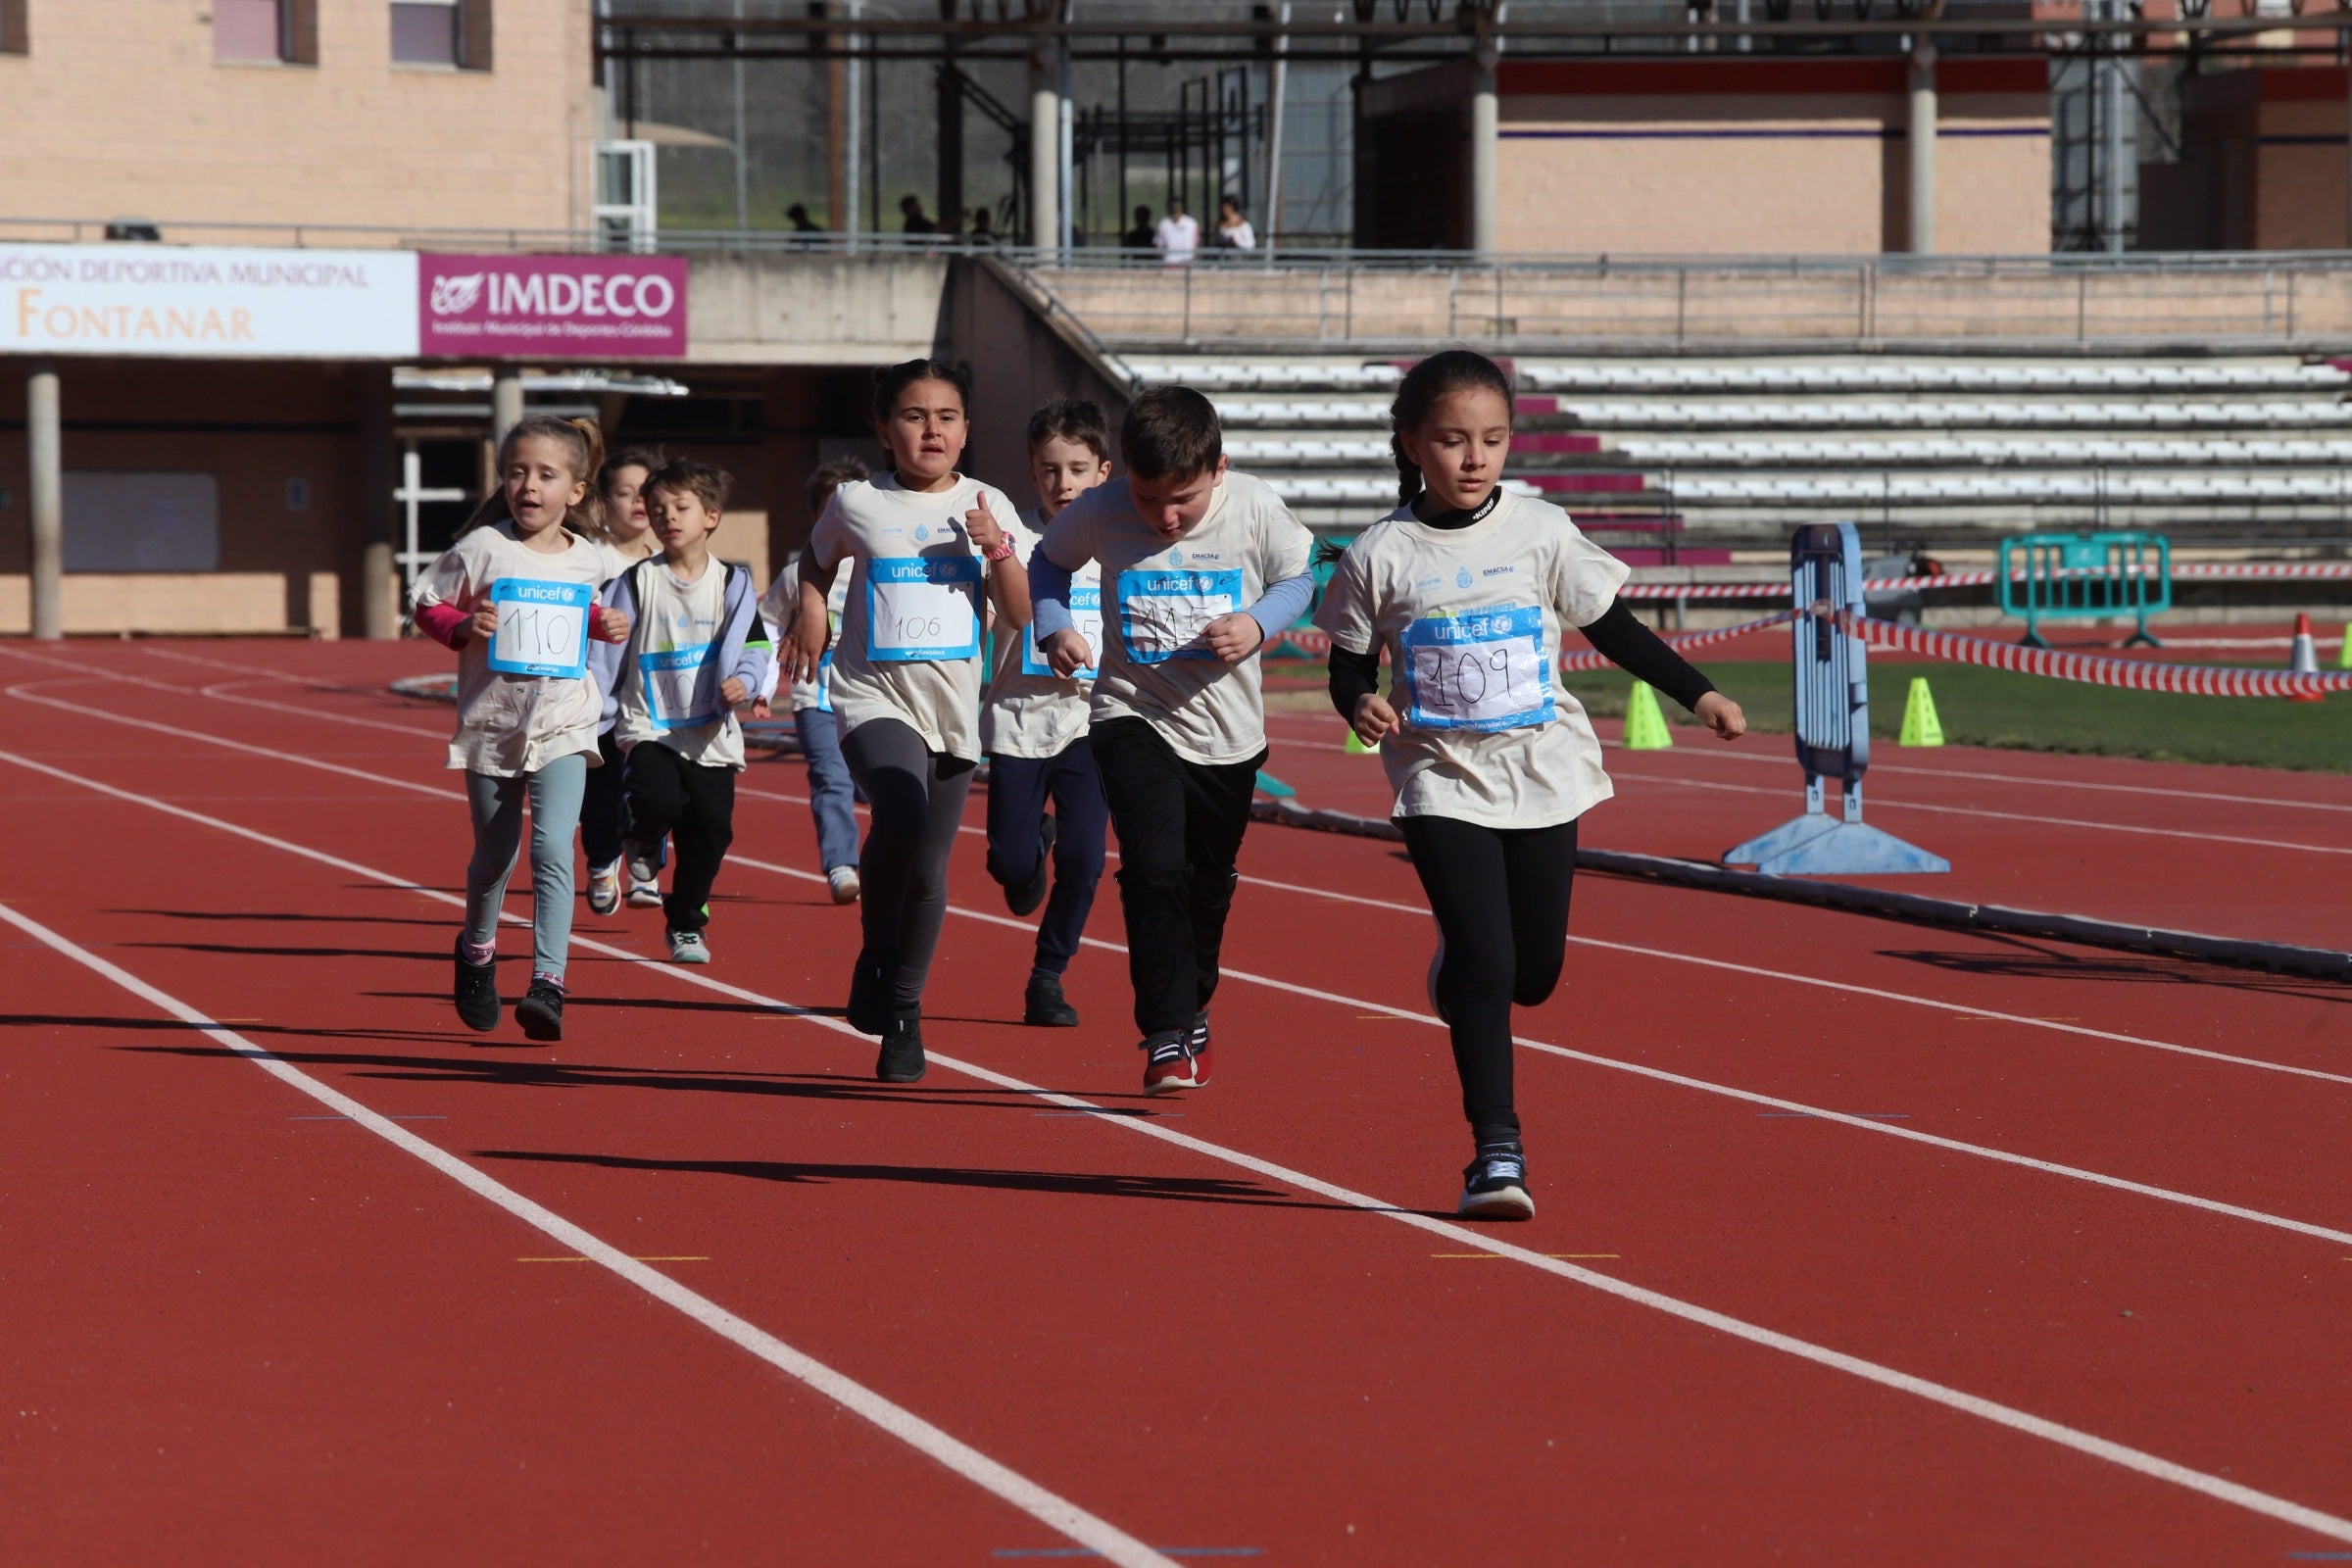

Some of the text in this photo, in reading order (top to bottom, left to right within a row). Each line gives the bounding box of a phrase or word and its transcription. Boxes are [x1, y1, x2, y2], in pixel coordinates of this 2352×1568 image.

[0, 255, 370, 287] CIÓN DEPORTIVA MUNICIPAL
[487, 272, 675, 318] IMDECO
[18, 287, 255, 341] FONTANAR
[892, 563, 938, 578] unicef
[1483, 565, 1509, 575] EMACSA
[518, 584, 562, 601] unicef
[1147, 575, 1195, 591] unicef
[504, 608, 571, 655] 110
[895, 616, 941, 642] 106
[1435, 617, 1489, 640] unicef
[660, 652, 693, 667] unicef
[1430, 648, 1511, 706] 109
